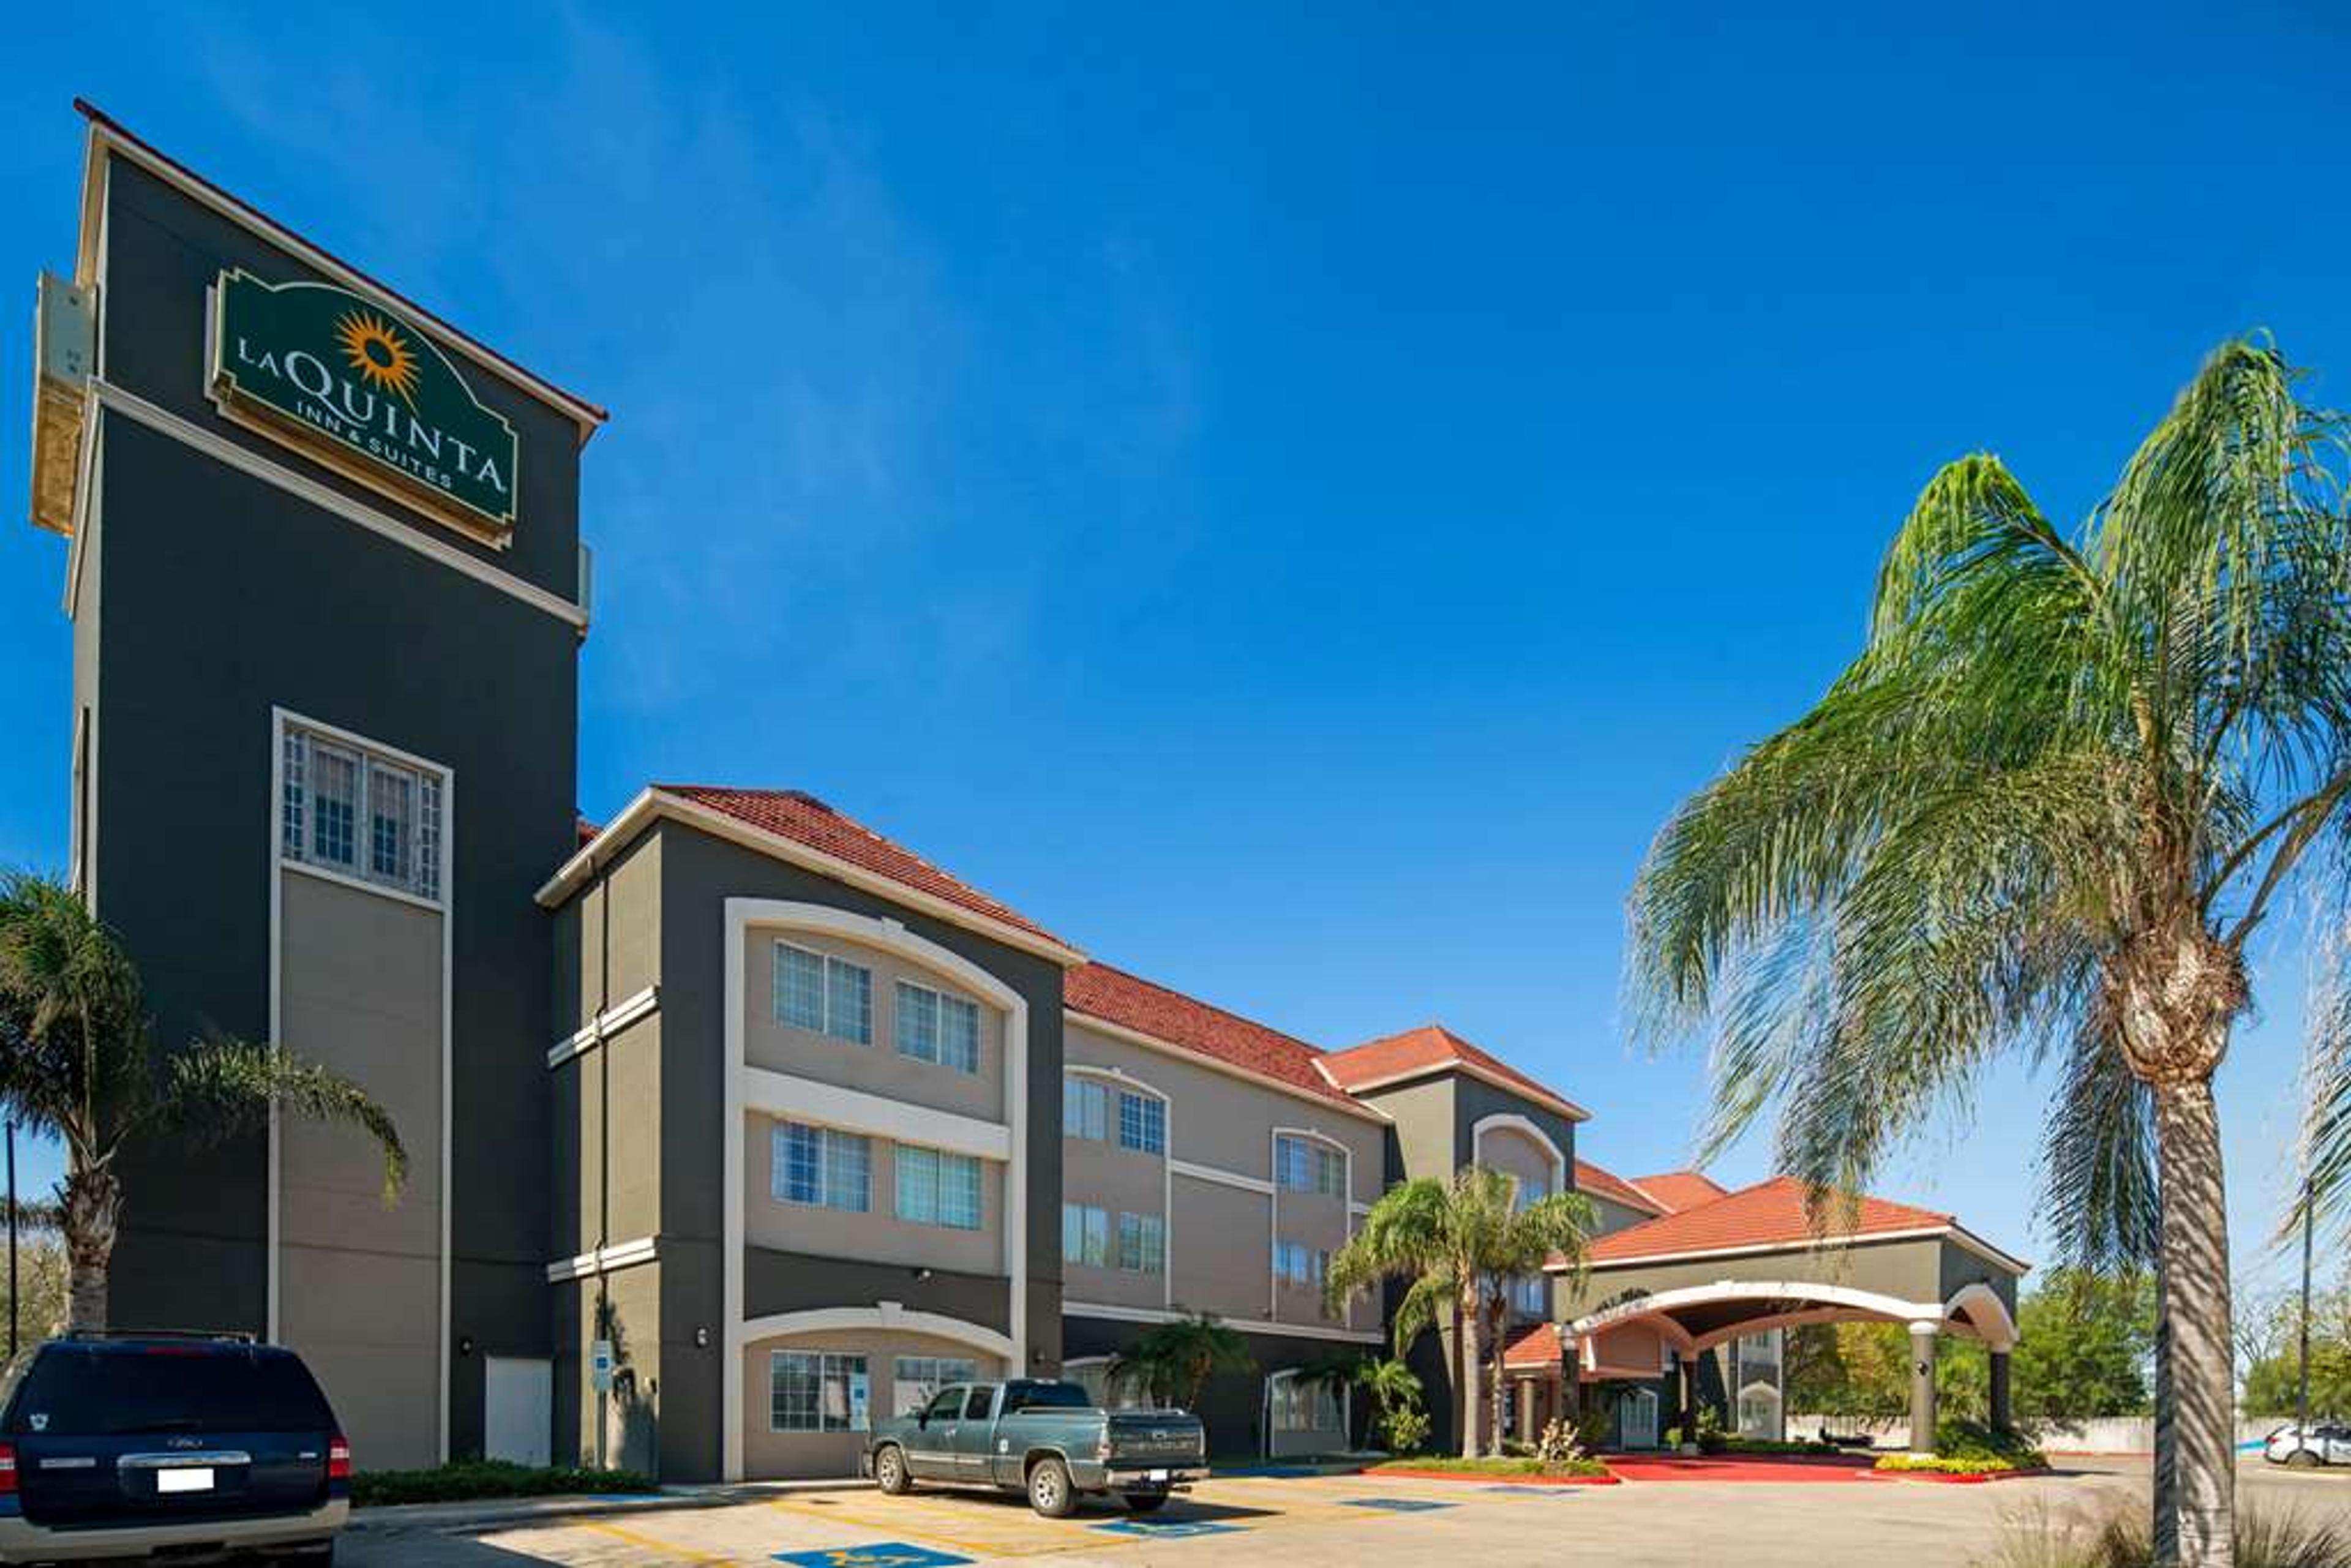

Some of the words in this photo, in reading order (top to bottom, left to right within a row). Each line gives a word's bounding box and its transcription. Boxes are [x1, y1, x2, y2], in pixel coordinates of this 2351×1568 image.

[239, 337, 279, 377] LA
[284, 351, 507, 492] QUINTA
[298, 401, 340, 432] INN
[348, 430, 360, 444] &
[369, 437, 451, 489] SUITES
